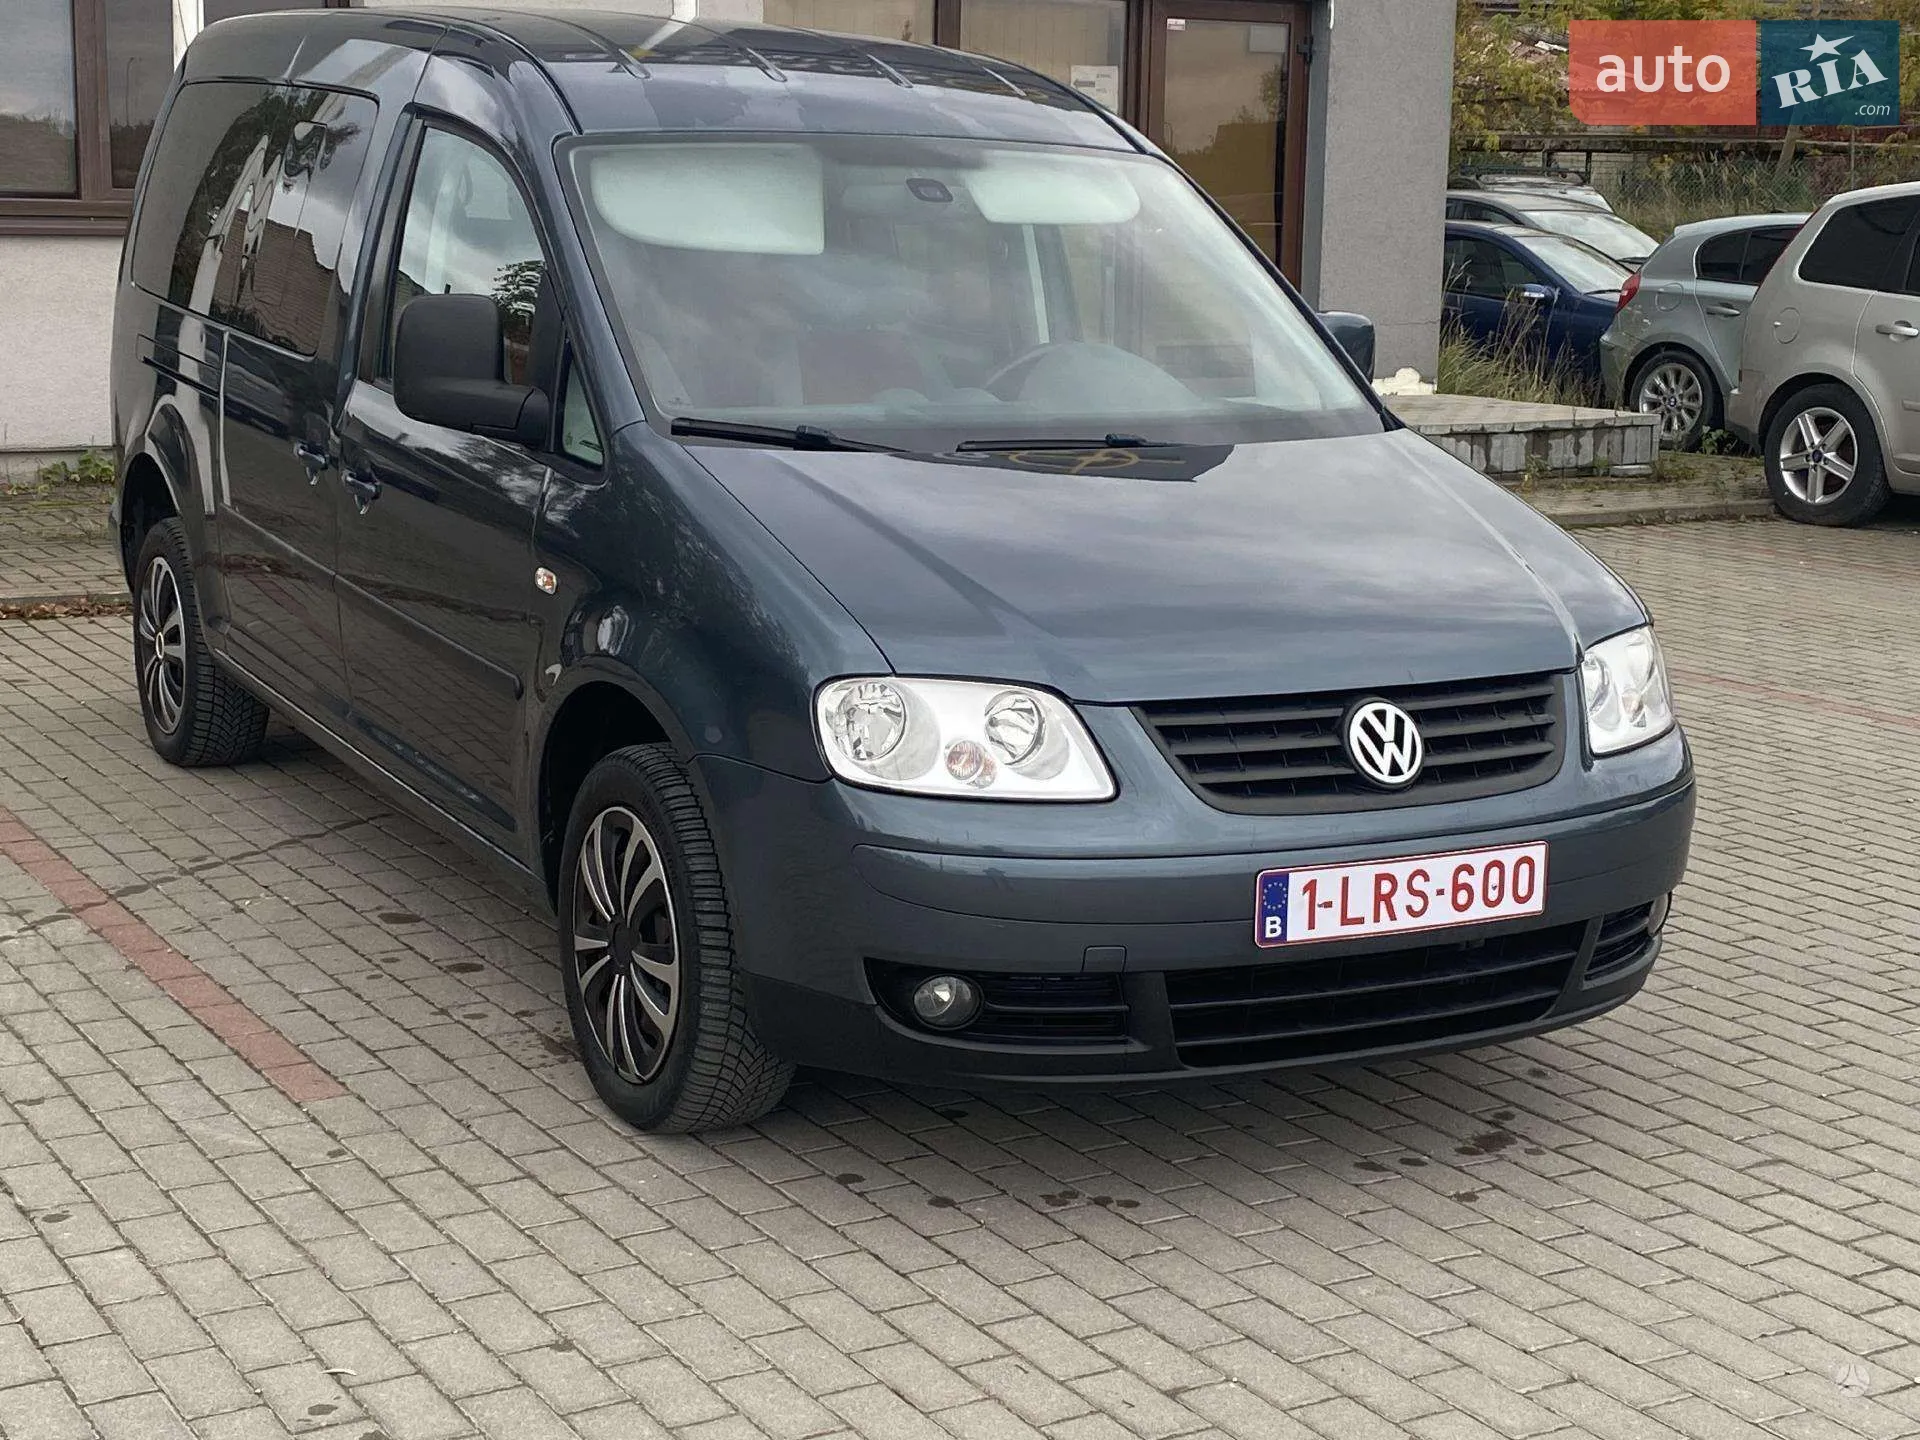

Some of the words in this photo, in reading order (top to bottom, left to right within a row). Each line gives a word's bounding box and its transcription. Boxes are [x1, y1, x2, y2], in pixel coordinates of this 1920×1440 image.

[1351, 703, 1420, 782] VW
[1265, 916, 1282, 938] B
[1302, 856, 1535, 930] 1-LRS-600
